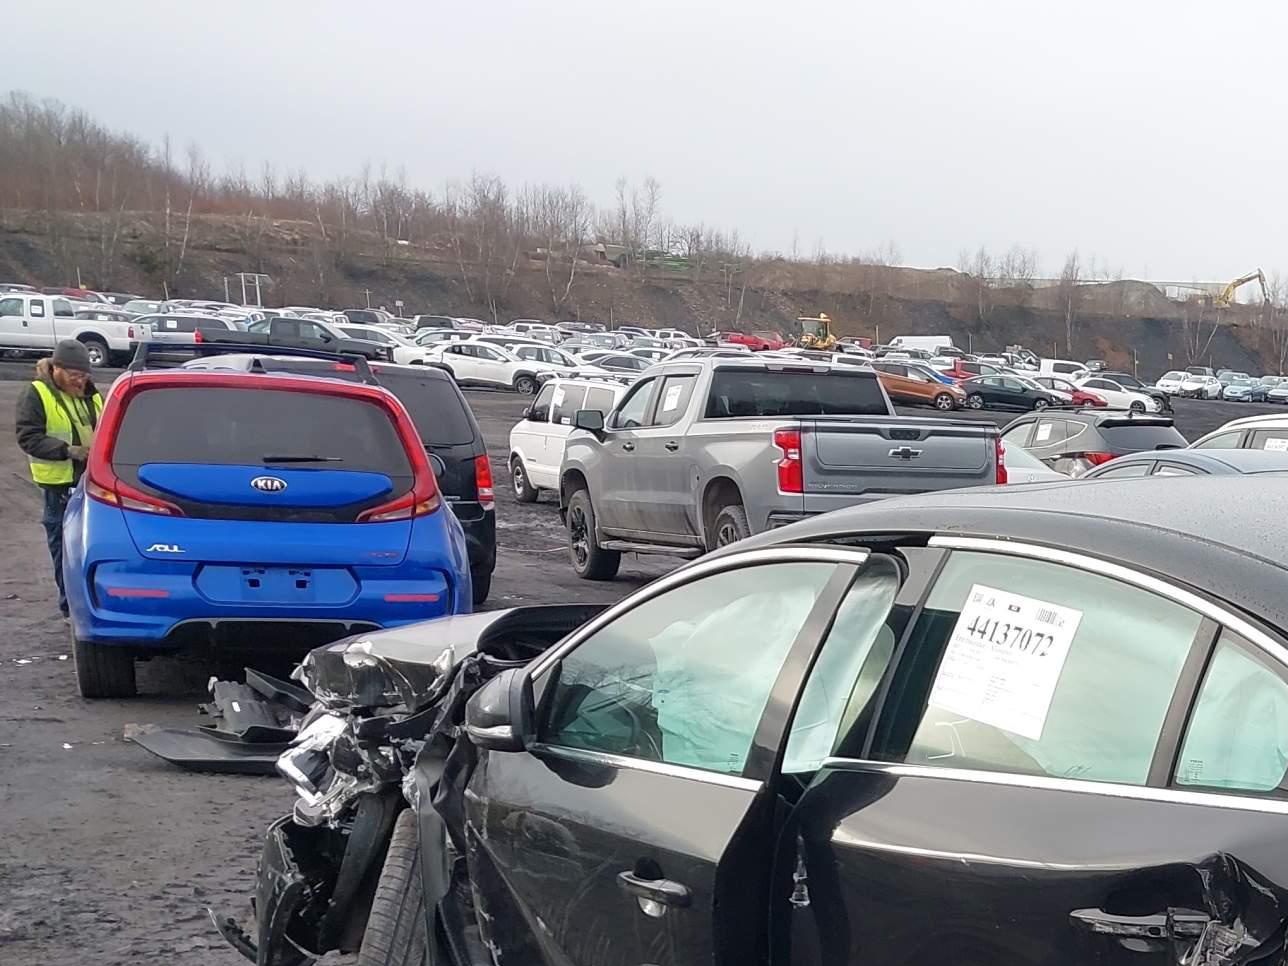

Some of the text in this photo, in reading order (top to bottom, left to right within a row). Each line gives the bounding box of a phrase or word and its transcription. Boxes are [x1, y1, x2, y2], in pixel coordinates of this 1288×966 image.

[257, 479, 281, 490] KIA
[145, 543, 186, 553] SOUL
[967, 615, 1054, 657] 44137072
